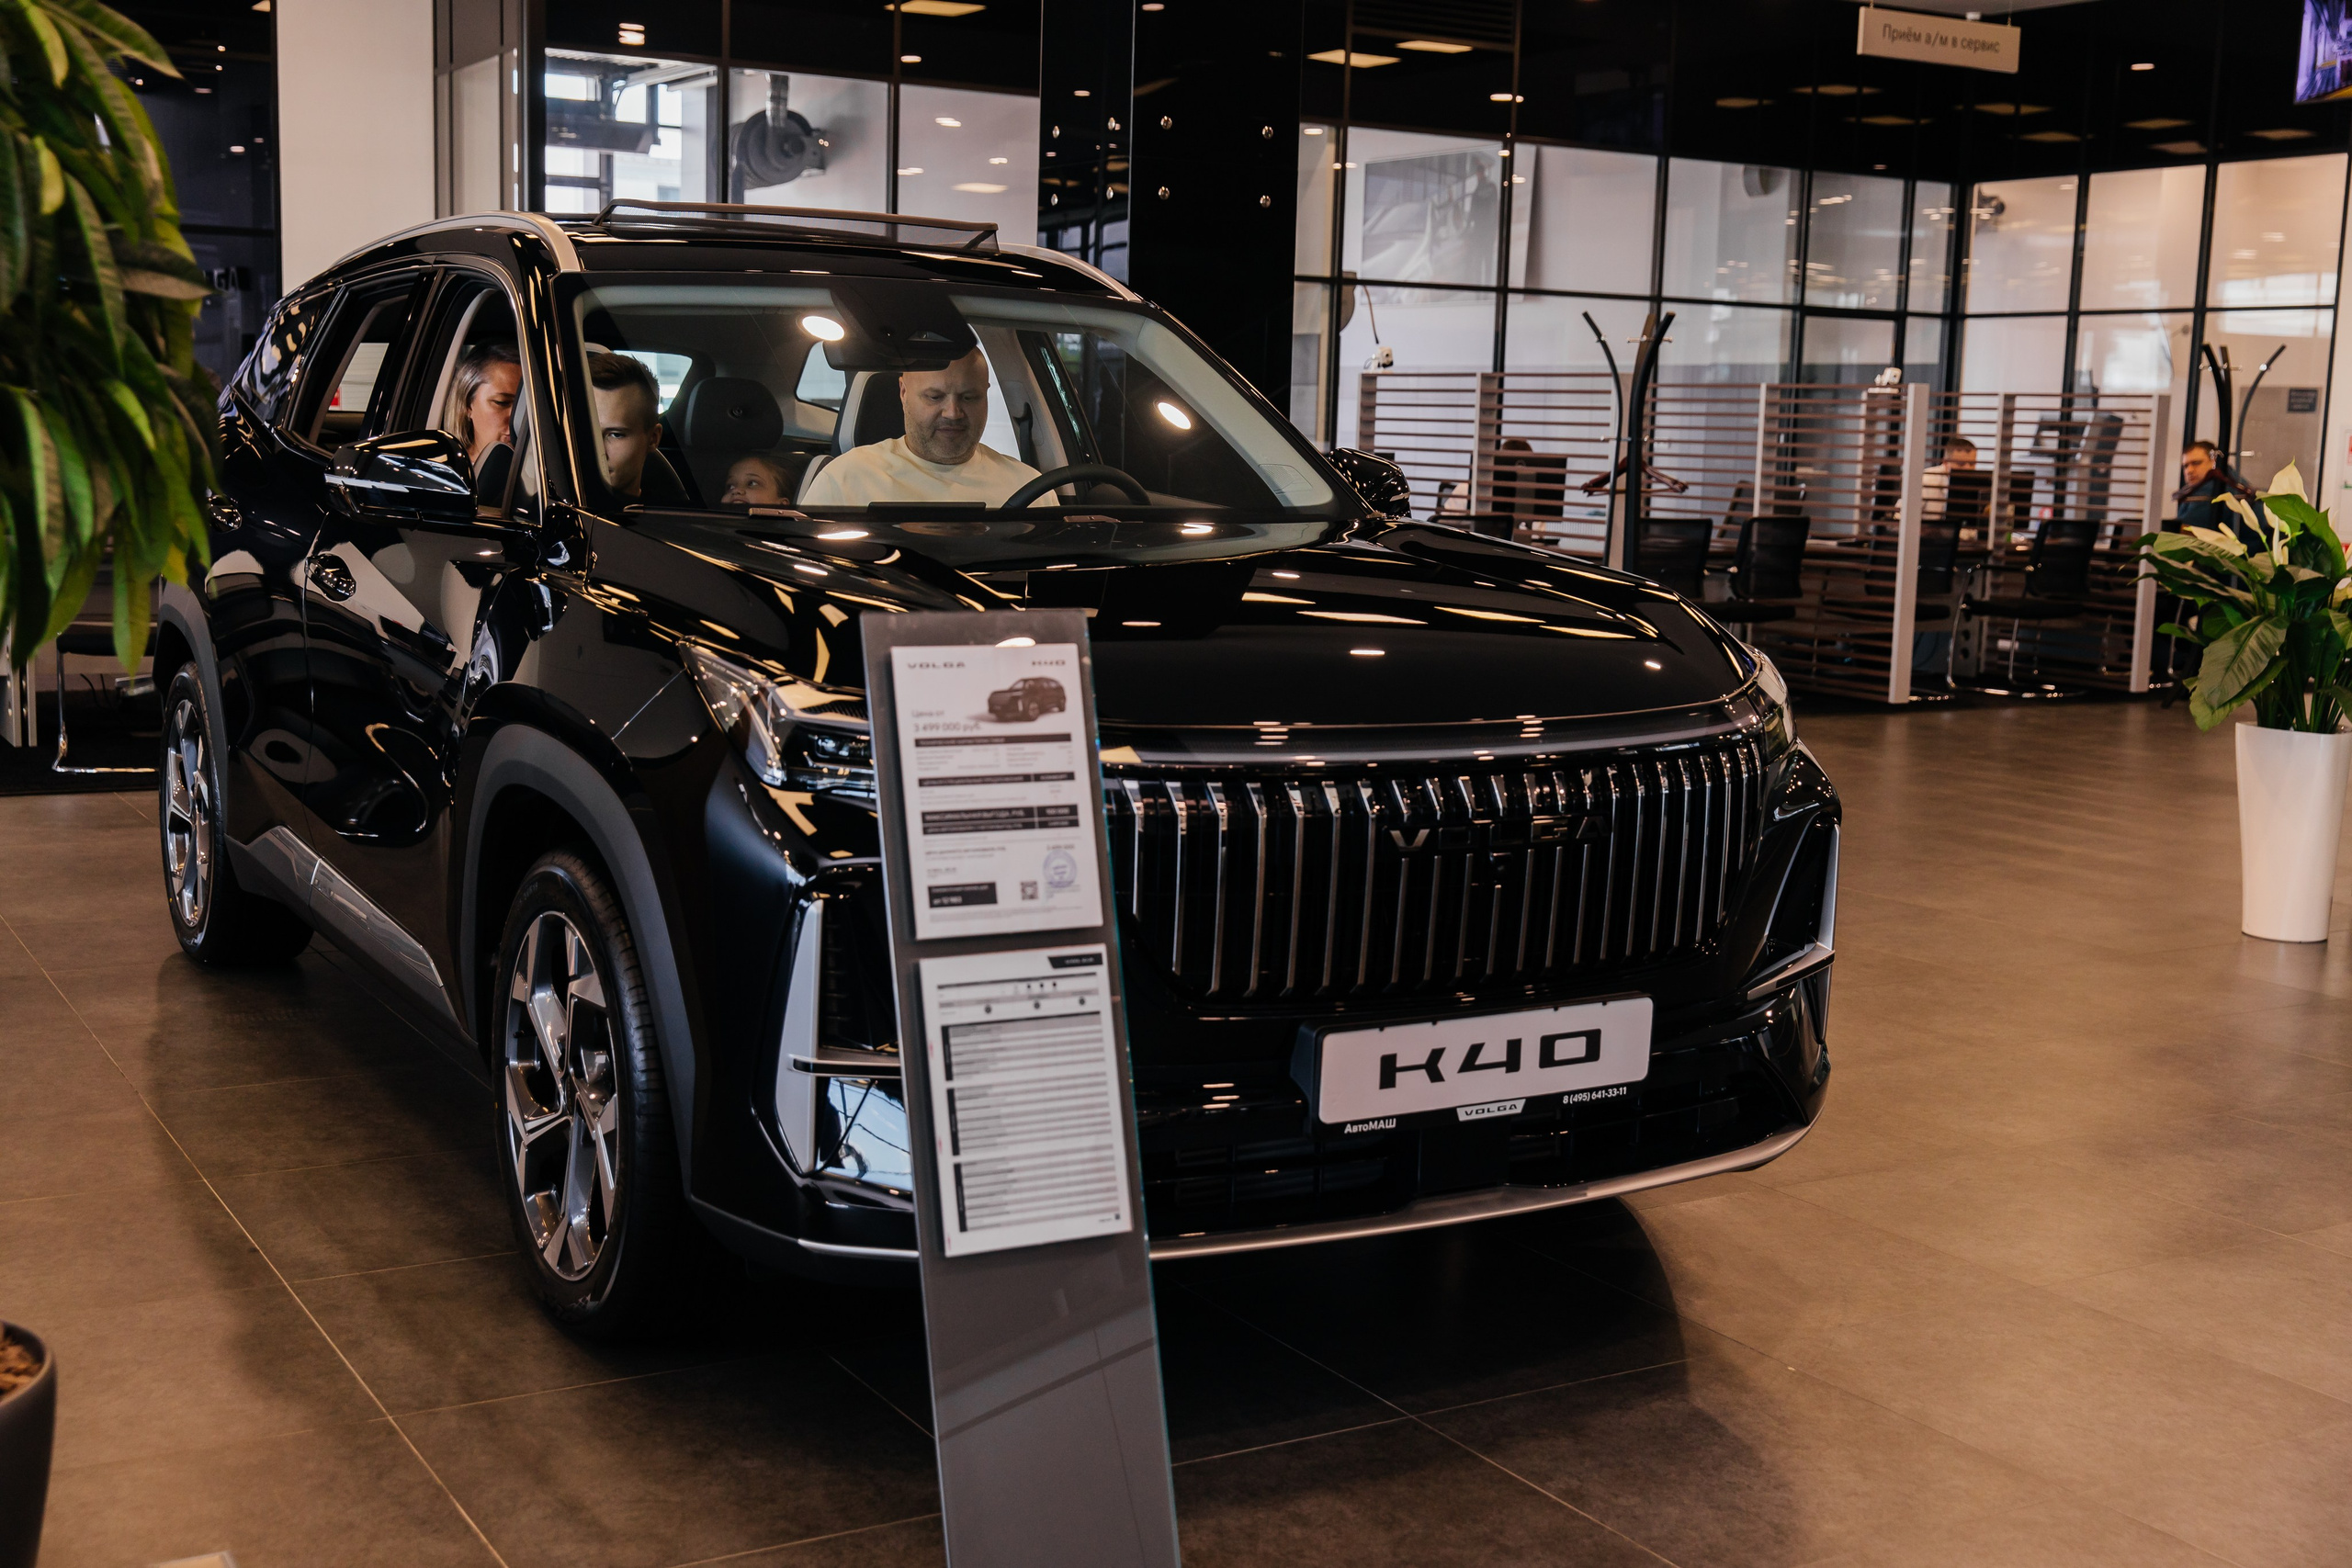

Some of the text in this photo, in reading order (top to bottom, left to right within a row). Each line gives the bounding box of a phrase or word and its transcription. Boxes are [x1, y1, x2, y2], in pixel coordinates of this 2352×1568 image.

[1882, 22, 2001, 54] Приём а/м в сервис
[1379, 1028, 1601, 1090] K40
[1563, 1086, 1628, 1105] 8 (495) 641-33-11
[1464, 1102, 1519, 1117] VOLGA
[1344, 1118, 1397, 1134] АвтоМАШ
